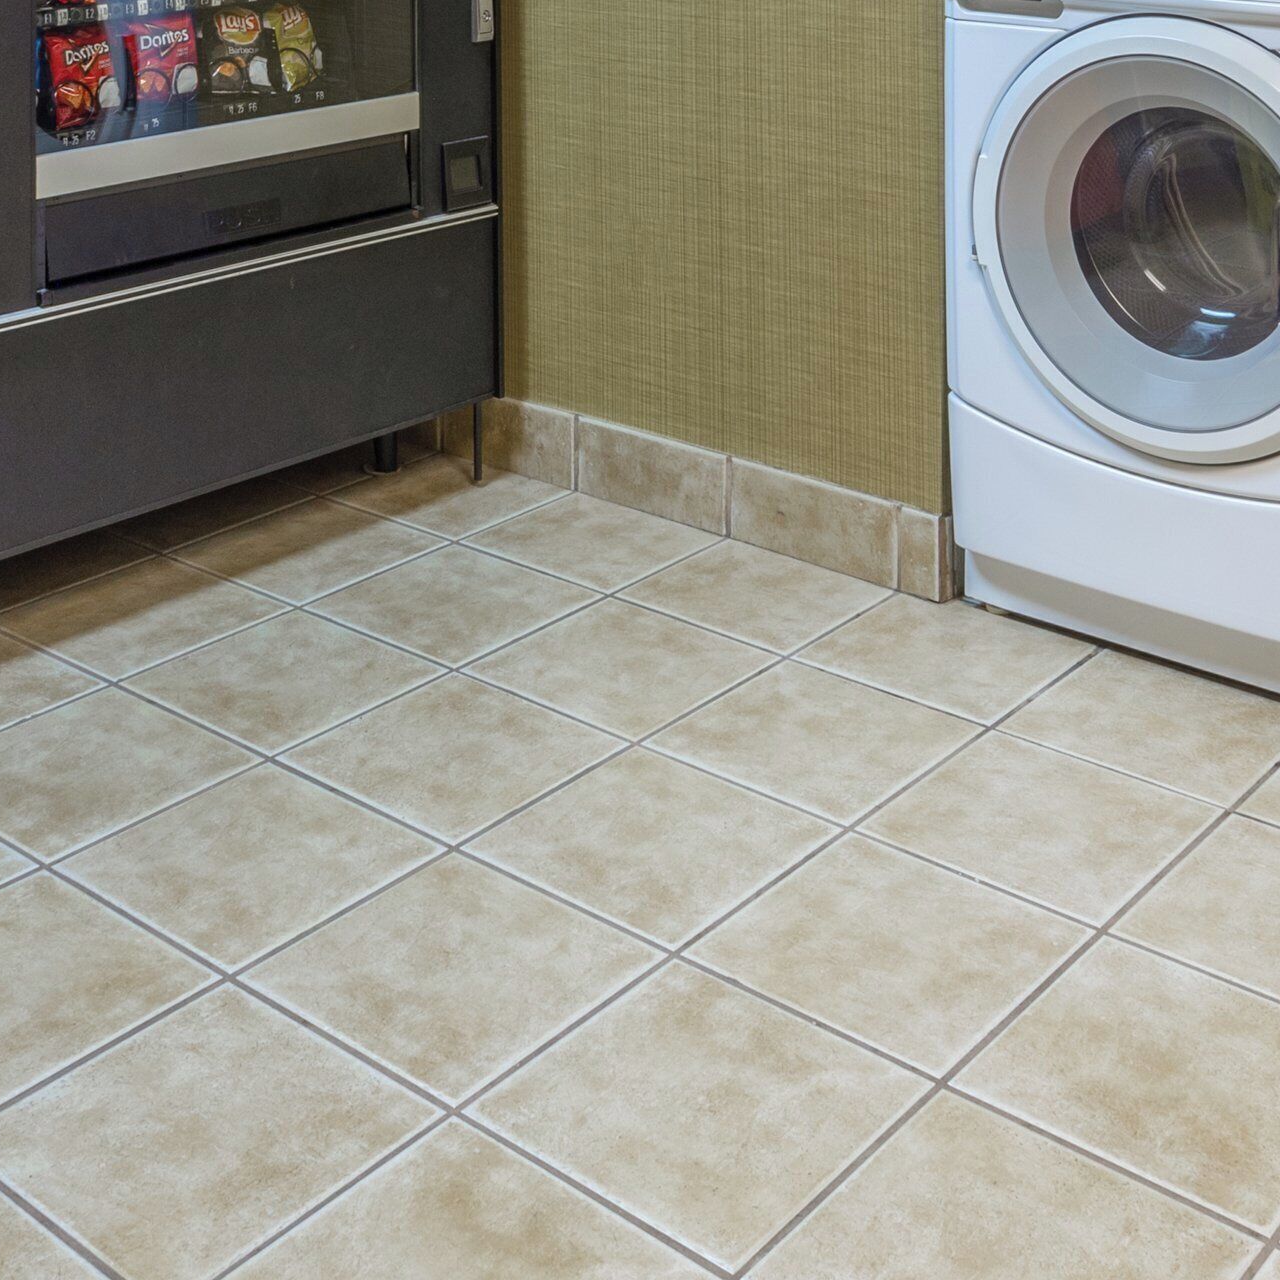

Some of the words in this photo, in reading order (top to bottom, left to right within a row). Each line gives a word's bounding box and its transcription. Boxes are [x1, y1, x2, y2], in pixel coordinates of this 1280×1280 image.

[125, 4, 134, 14] E3
[165, 0, 174, 9] E4
[44, 14, 52, 24] E1
[85, 9, 94, 19] E2
[220, 14, 255, 33] Lay's
[140, 28, 190, 50] Doritos
[65, 40, 110, 65] Doritos
[315, 91, 325, 101] F8
[248, 102, 258, 113] F6
[86, 129, 96, 141] F2
